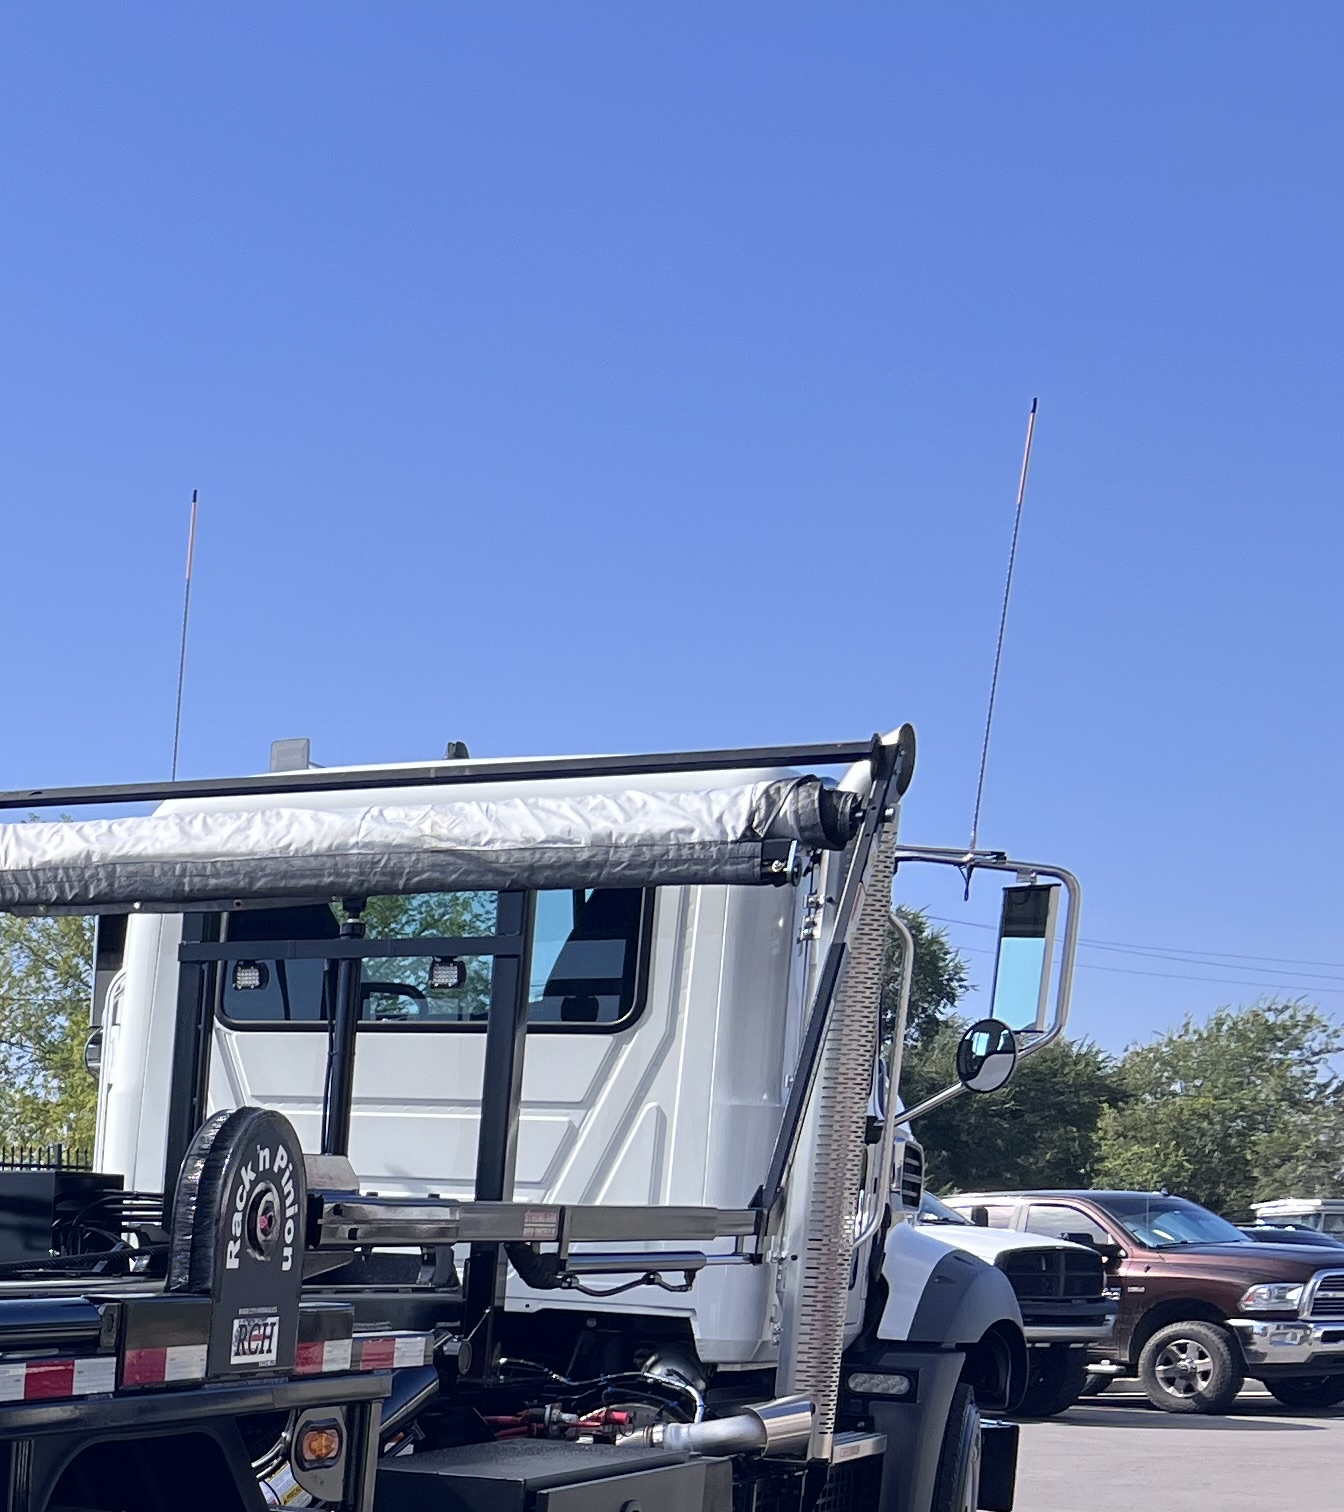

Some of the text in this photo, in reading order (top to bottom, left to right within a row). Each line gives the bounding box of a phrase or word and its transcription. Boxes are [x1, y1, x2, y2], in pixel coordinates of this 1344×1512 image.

[225, 1160, 256, 1269] Rack
[273, 1144, 298, 1271] Pinion
[234, 1321, 276, 1356] RCH
